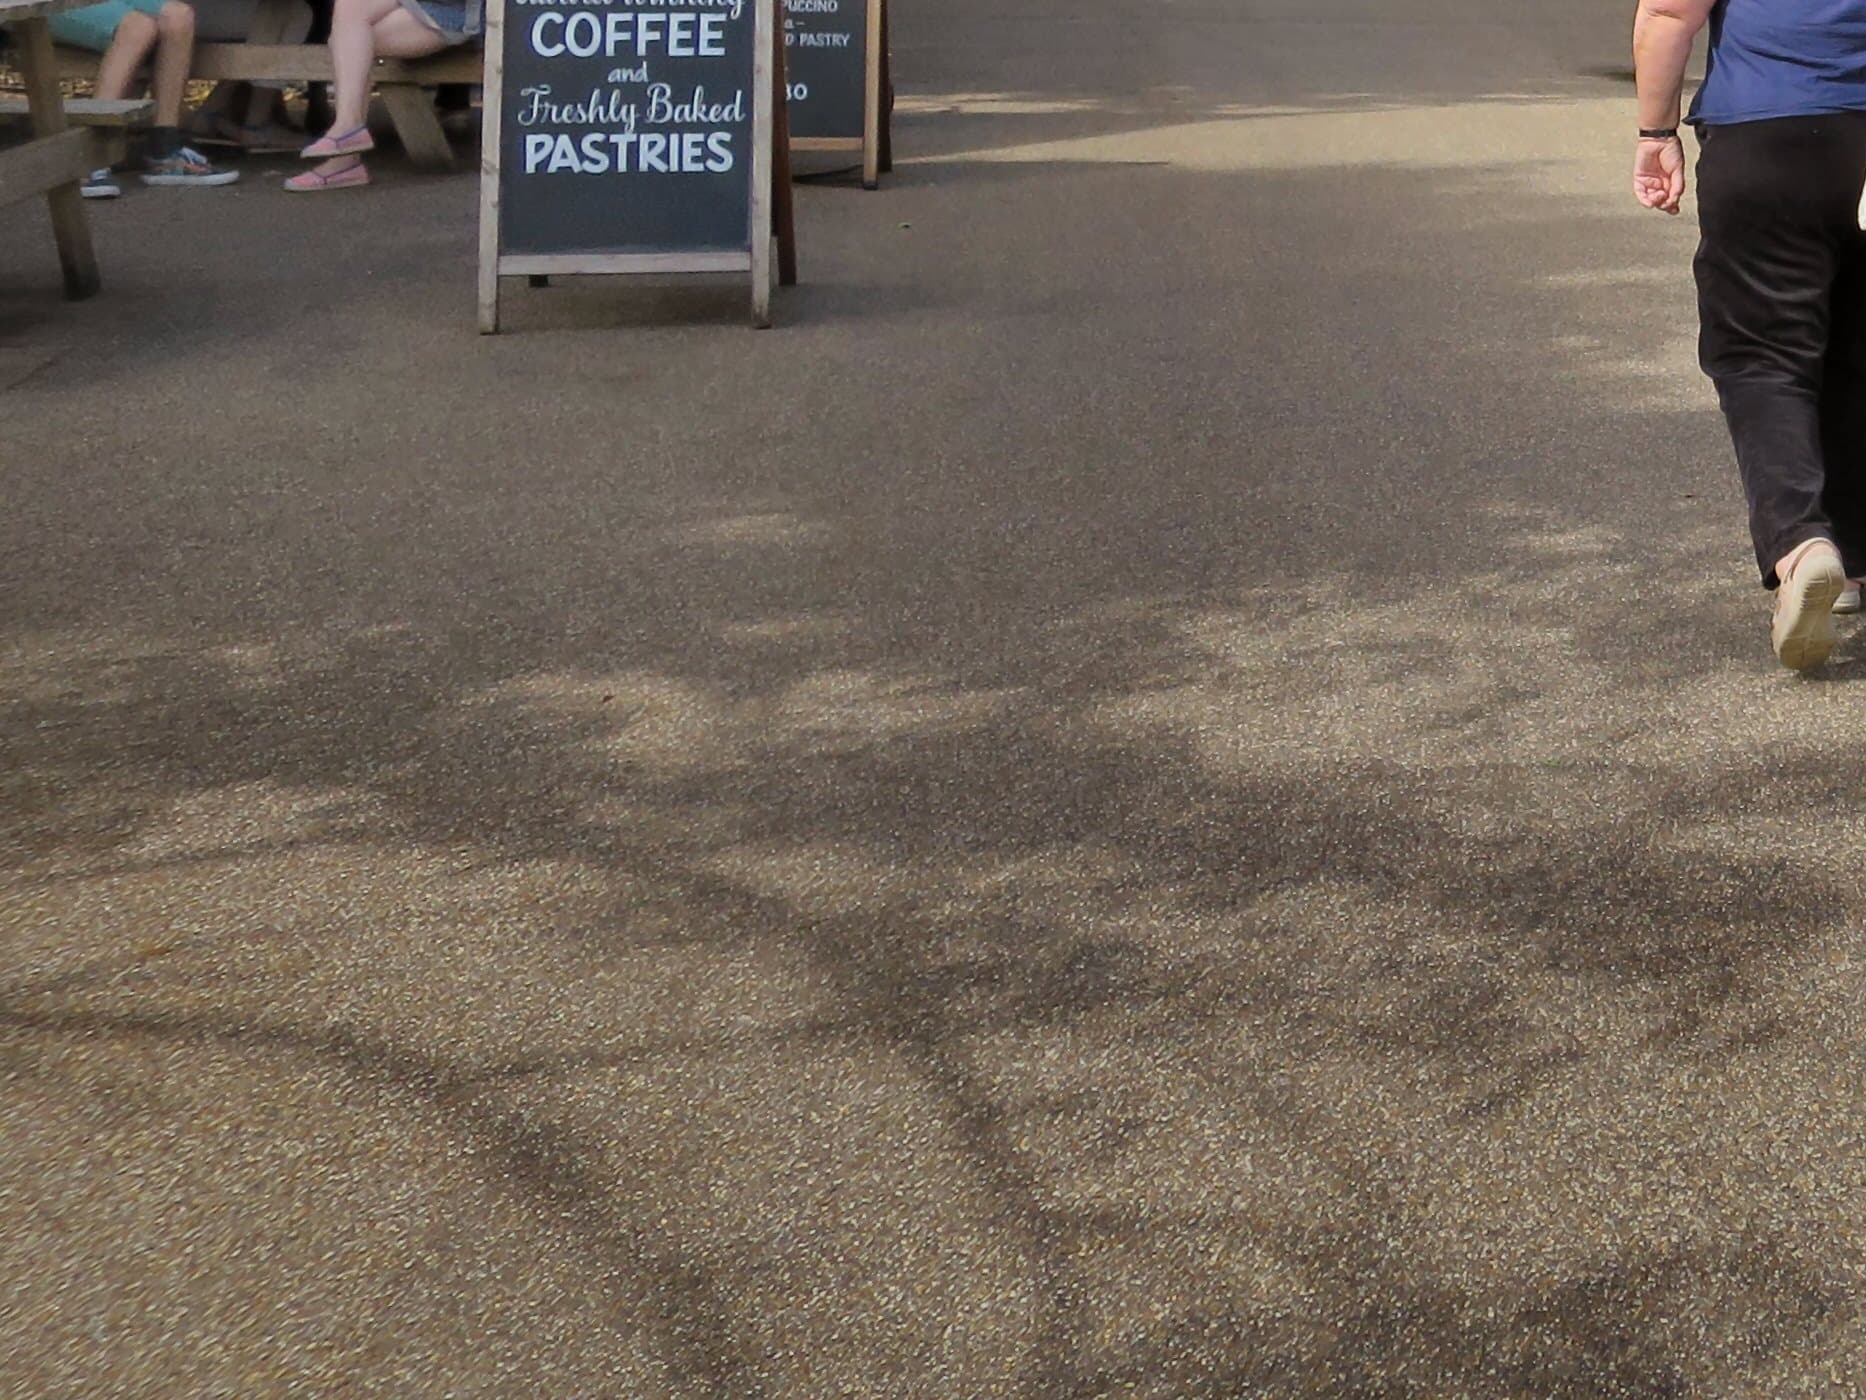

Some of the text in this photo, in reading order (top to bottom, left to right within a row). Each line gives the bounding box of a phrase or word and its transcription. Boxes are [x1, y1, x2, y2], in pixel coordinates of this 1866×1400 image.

[531, 11, 728, 57] COFFEE
[799, 33, 850, 48] PASTRY
[607, 61, 649, 83] and
[517, 82, 746, 134] Freshly Baked
[525, 131, 734, 174] PASTRIES
